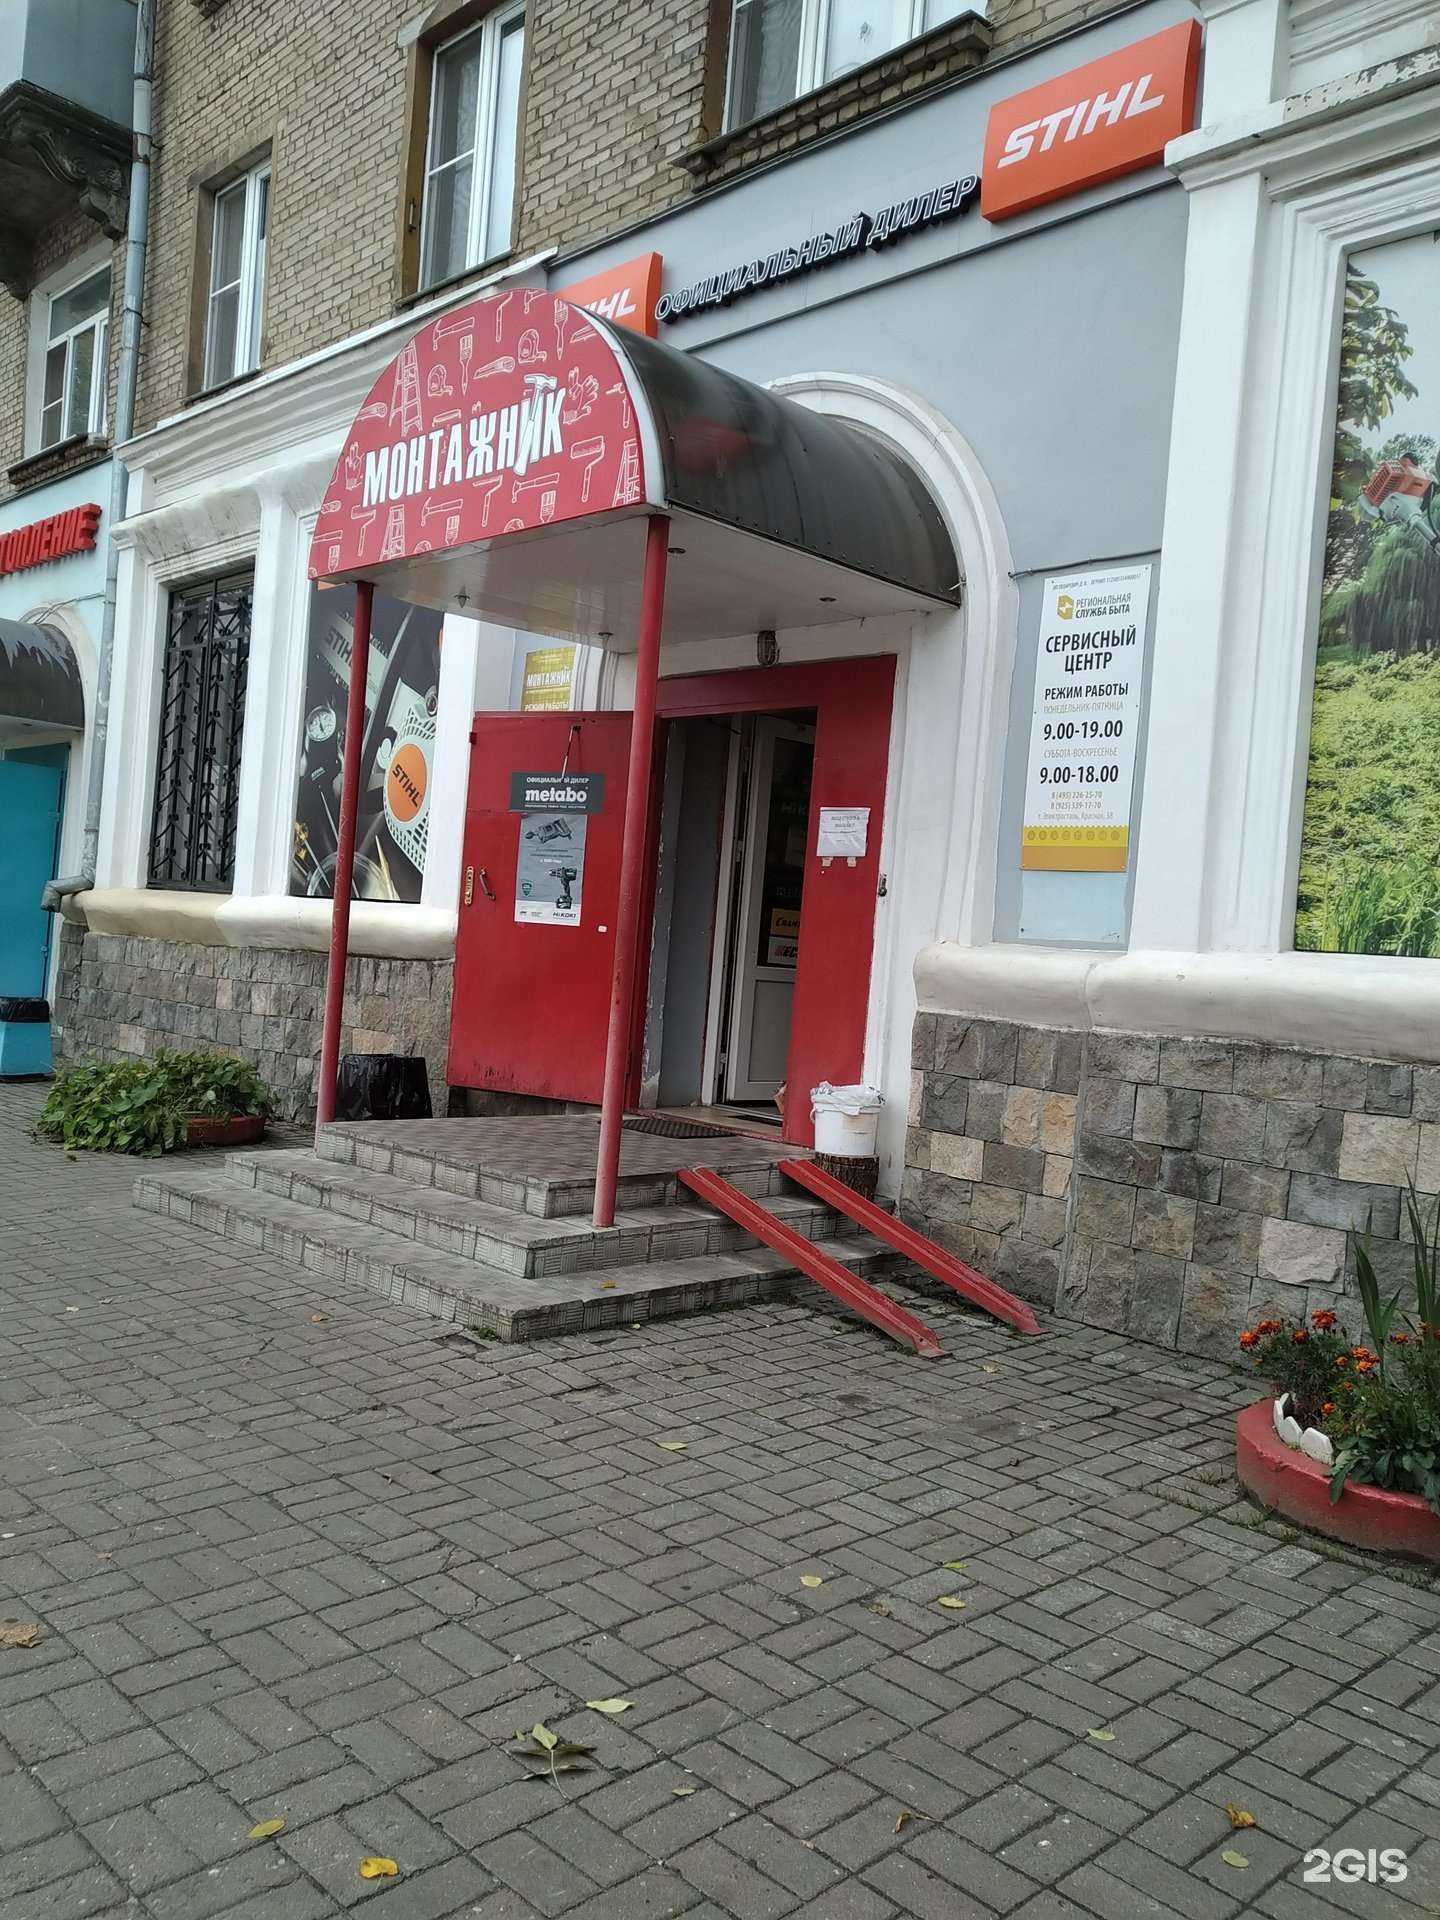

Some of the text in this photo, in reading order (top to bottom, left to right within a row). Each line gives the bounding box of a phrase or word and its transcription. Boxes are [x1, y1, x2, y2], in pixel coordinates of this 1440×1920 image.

[997, 74, 1165, 169] STIHL
[654, 174, 979, 322] ОФИЦИАЛЬНЫЙ ДИЛЕР
[362, 382, 566, 507] МОНТАЖНИК
[1075, 603, 1130, 619] СЛУЖБА БЫТА
[1076, 593, 1131, 608] РЕГИОНАЛЬНАЯ
[1046, 624, 1137, 653] СЕРВИСНЫЙ
[1064, 651, 1113, 675] ЦЕНТР
[1045, 683, 1128, 700] РЕЖИМ РАБОТЫ
[1044, 720, 1123, 740] 9.00-19.00
[392, 764, 423, 807] STIHL
[1040, 765, 1119, 784] 9.00-18.00
[525, 786, 588, 803] metabo
